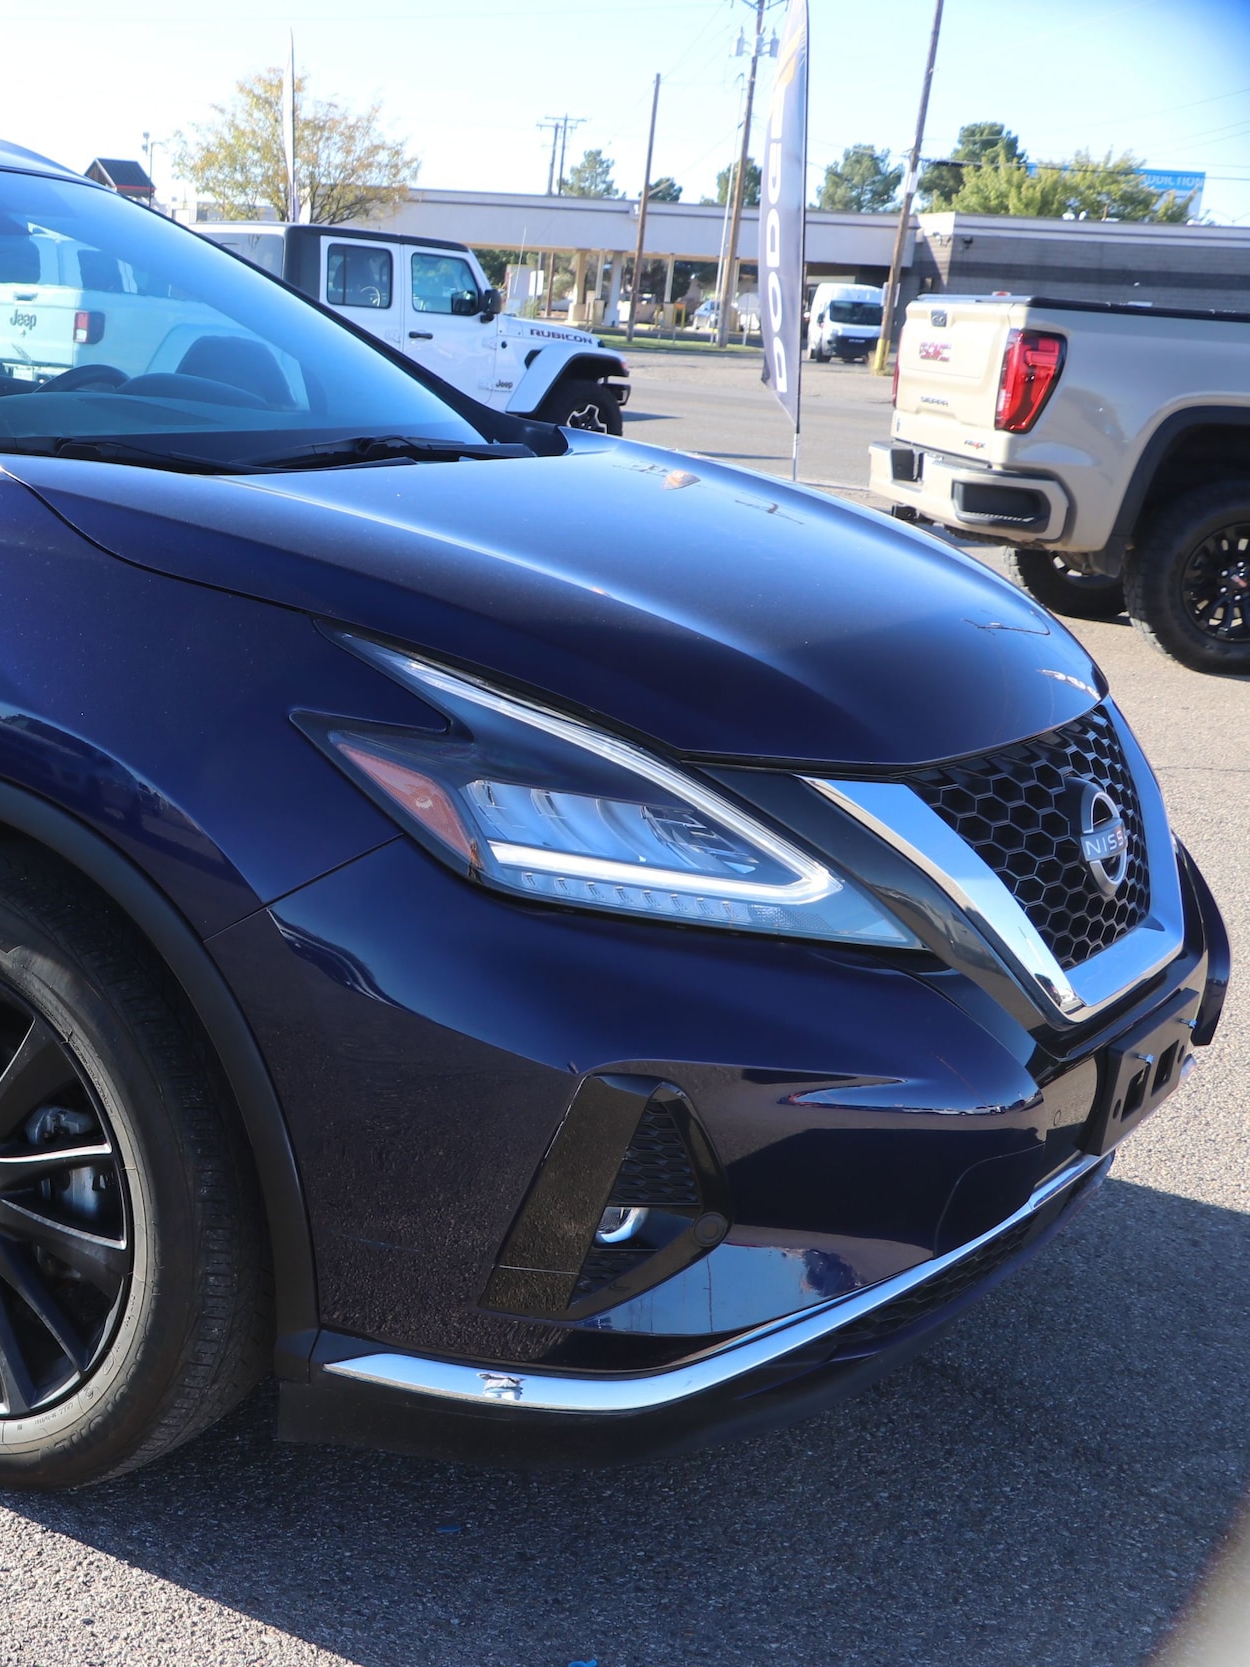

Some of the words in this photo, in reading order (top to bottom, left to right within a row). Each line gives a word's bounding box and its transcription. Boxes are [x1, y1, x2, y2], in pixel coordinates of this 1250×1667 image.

[10, 309, 37, 331] Jeep
[530, 328, 593, 345] RUBICON
[495, 379, 514, 389] Jeep
[1085, 830, 1127, 856] NISS
